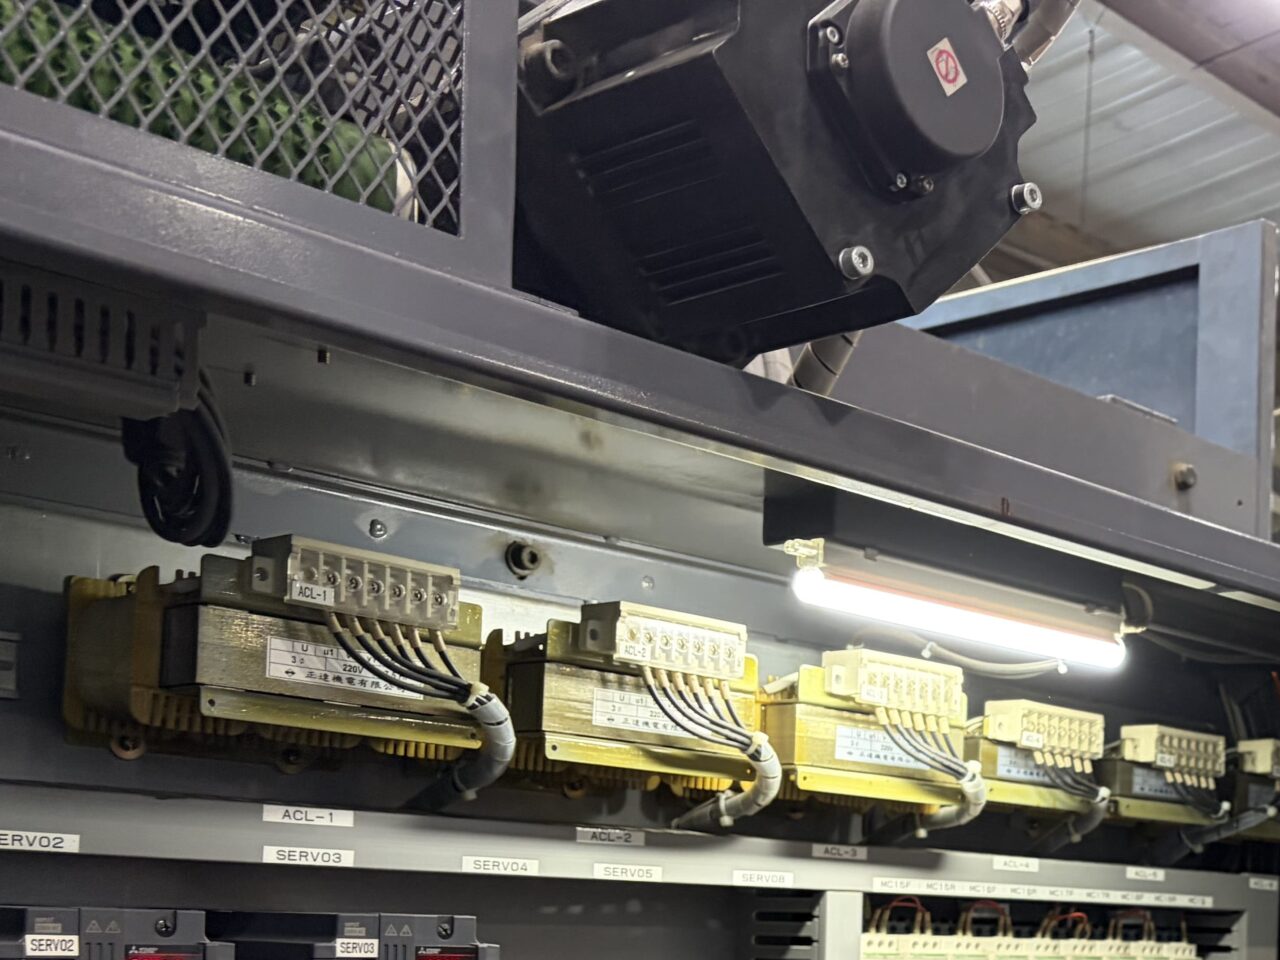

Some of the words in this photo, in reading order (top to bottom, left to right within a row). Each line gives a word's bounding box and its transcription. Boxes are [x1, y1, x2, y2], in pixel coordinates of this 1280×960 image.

[297, 585, 328, 602] ACL-1
[281, 808, 335, 824] ACL-1
[589, 830, 633, 844] ACL-2
[823, 847, 858, 859] ACL-3
